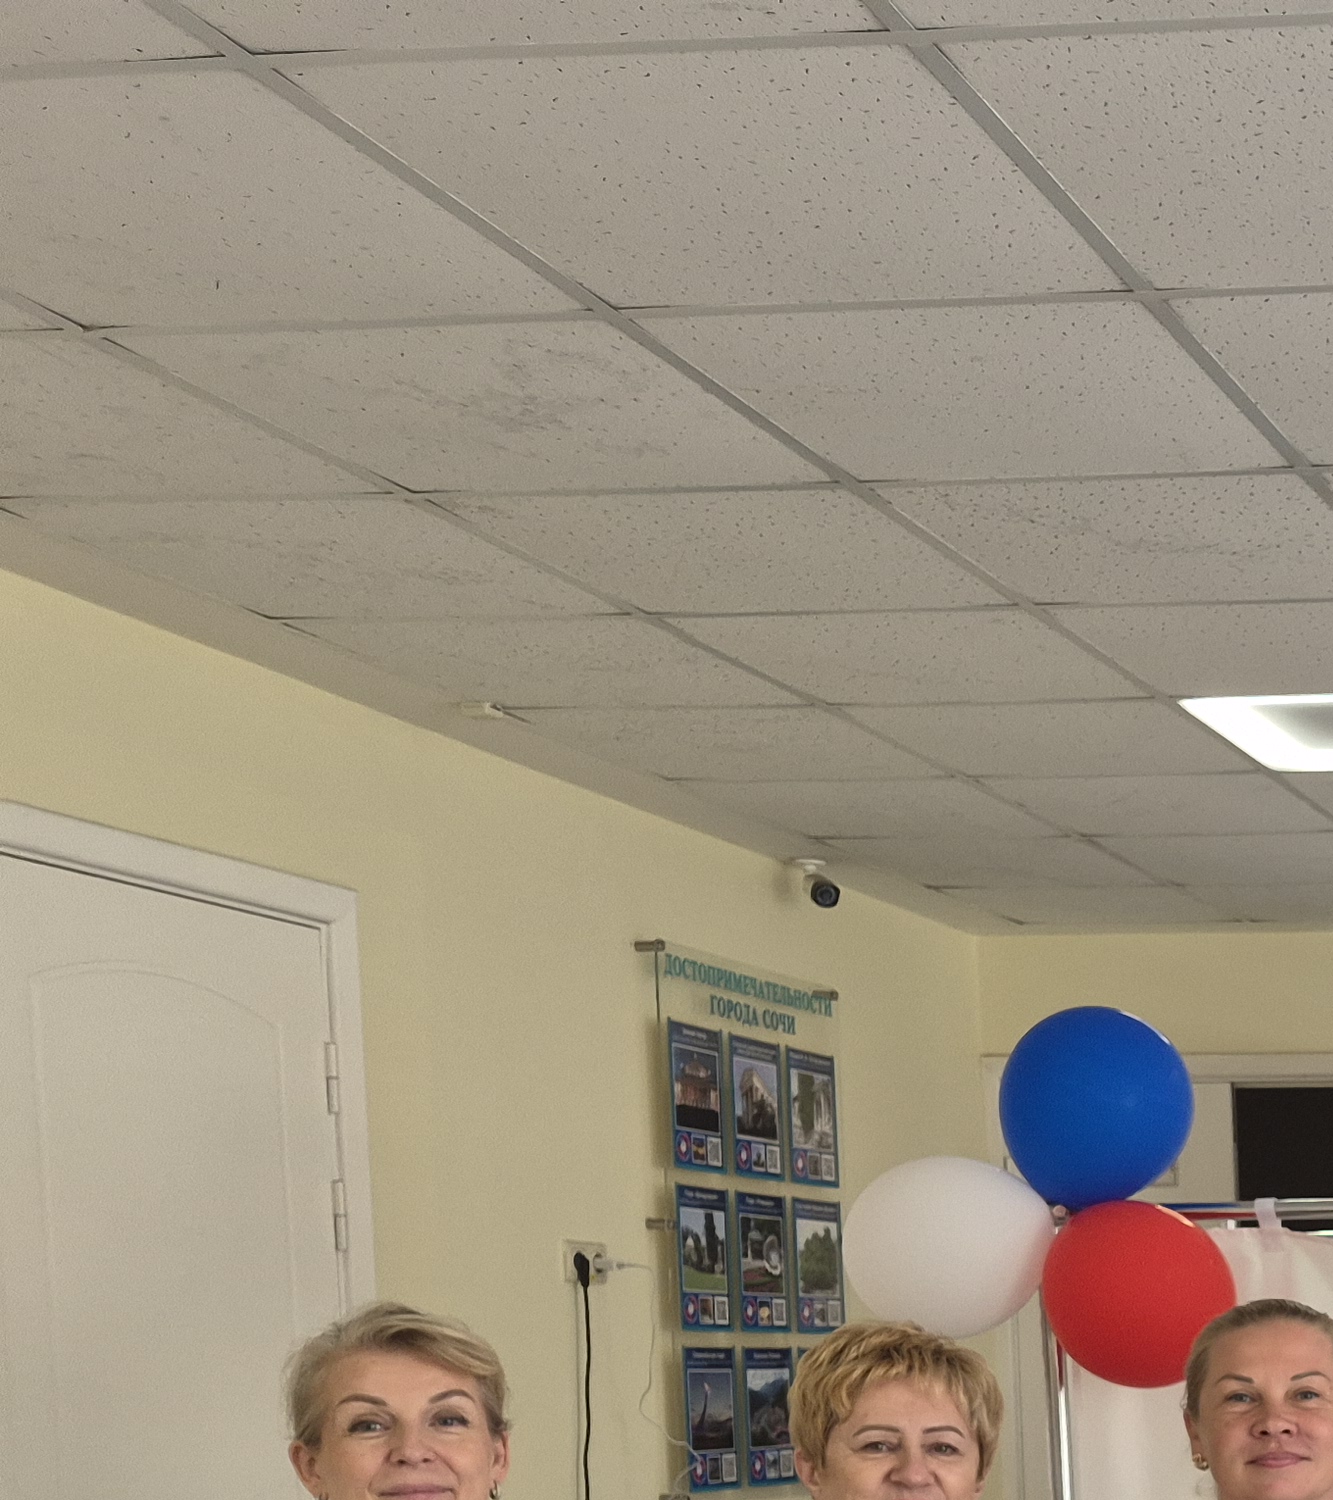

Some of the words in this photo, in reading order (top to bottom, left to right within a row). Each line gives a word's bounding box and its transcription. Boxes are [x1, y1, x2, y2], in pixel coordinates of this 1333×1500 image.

[665, 953, 832, 1017] ДОСТОПРИМЕЧАТЕЛЬНОСТИ
[710, 995, 759, 1027] ГОРОДА
[763, 1009, 796, 1035] СОЧИ
